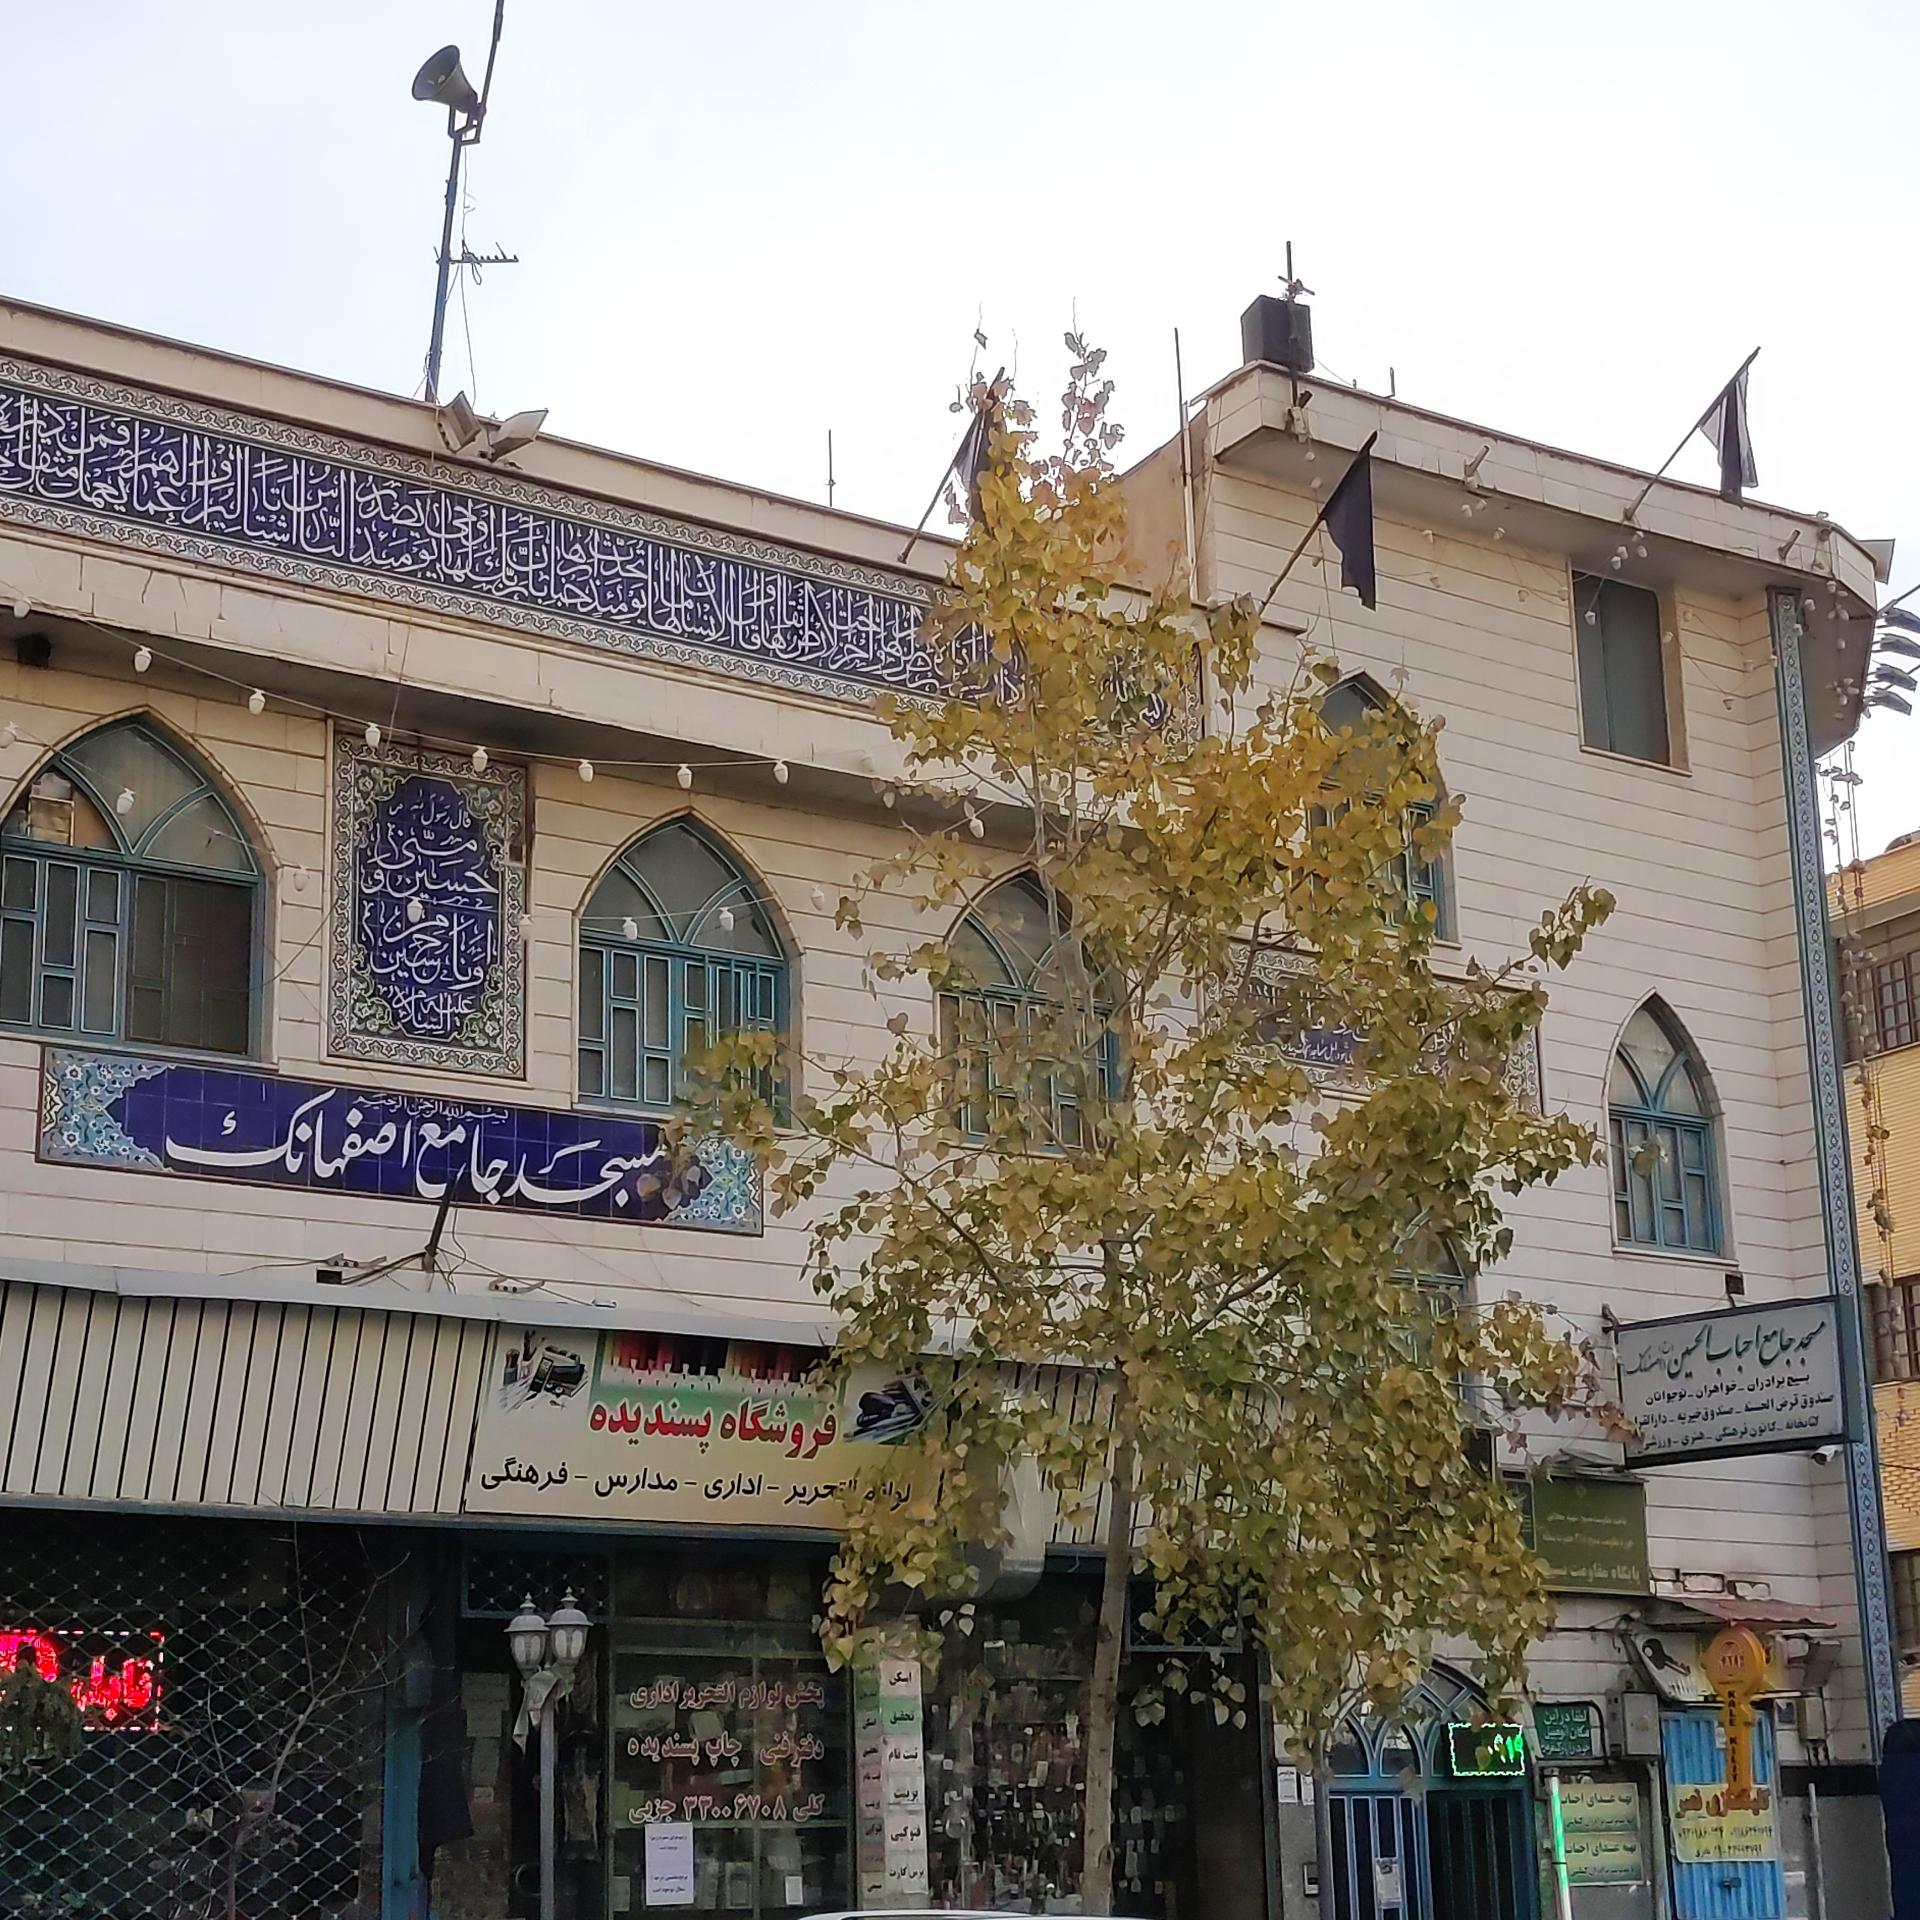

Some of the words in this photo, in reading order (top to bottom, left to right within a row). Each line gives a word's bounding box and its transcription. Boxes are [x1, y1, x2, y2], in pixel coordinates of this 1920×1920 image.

[1758, 1327, 1797, 1368] جامع
[1791, 1320, 1826, 1367] مسجد
[1696, 1379, 1737, 1399] خواهران
[1747, 1375, 1786, 1392] برادران
[1787, 1374, 1811, 1387] بسیج
[1776, 1393, 1799, 1412] قرض
[1800, 1392, 1835, 1410] صندوق
[589, 1401, 713, 1454] پسندیده
[720, 1401, 838, 1459] فروشگاه
[481, 1457, 568, 1491] فرهنگی
[594, 1467, 679, 1497] مدارس
[703, 1473, 763, 1500] اداری
[629, 1681, 680, 1710] اداری
[738, 1681, 784, 1710] لوازم
[705, 1730, 744, 1768] چاپ
